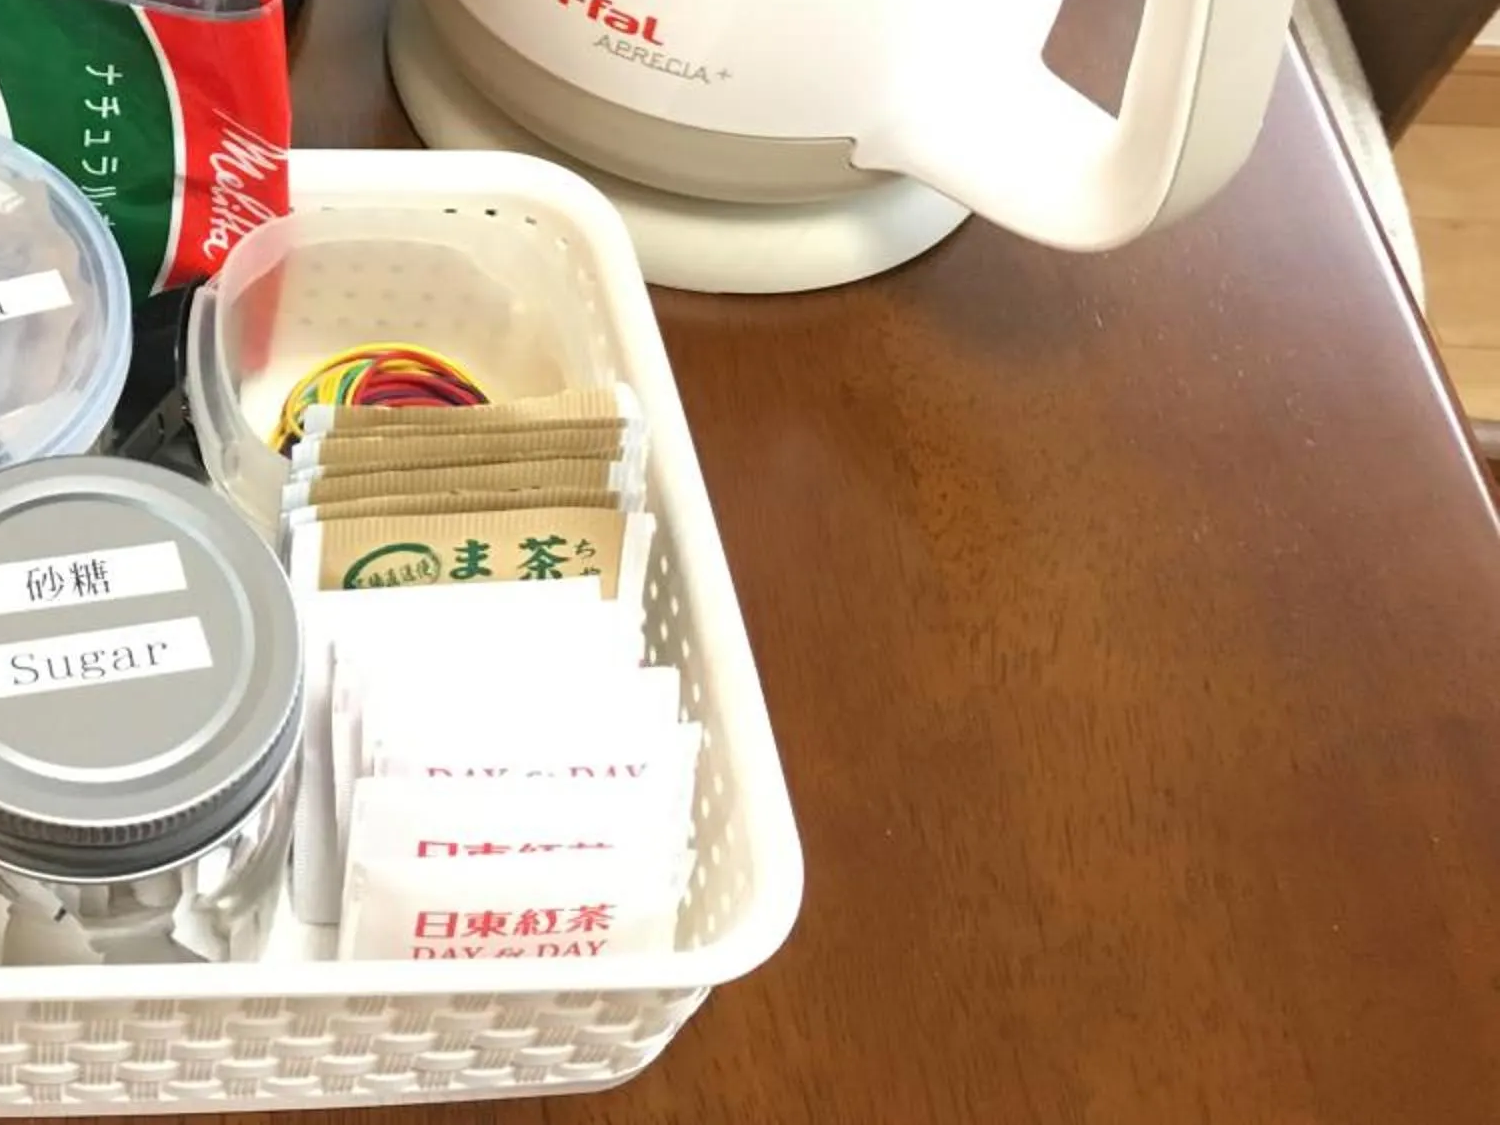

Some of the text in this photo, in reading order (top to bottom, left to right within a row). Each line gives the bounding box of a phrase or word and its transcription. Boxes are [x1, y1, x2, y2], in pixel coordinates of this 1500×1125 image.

[81, 63, 124, 227] ナチュラル
[25, 558, 111, 602] 砂糖
[9, 638, 169, 687] Sugar
[414, 904, 615, 939] 日東紅茶
